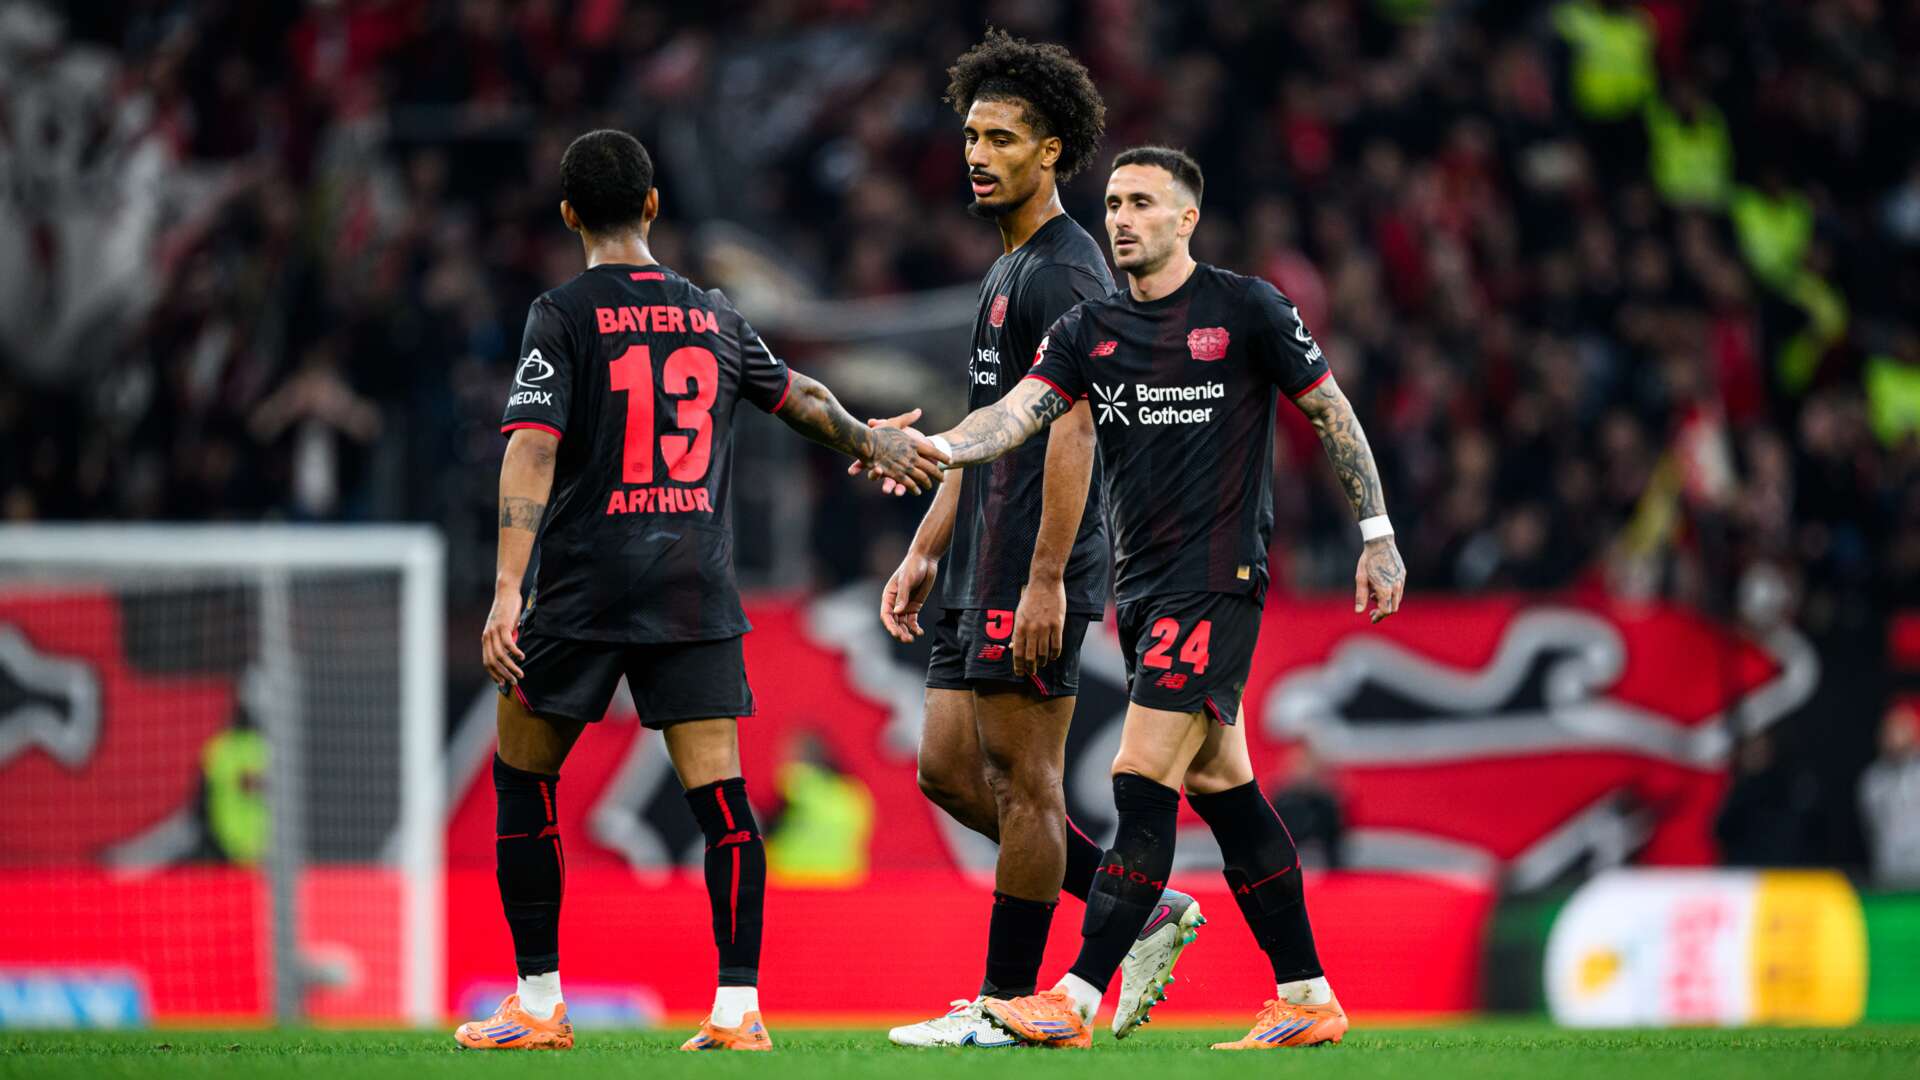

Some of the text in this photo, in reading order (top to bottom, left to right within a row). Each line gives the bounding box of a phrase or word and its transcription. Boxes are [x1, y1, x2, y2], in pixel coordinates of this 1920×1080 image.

[595, 305, 720, 335] BAYER 04
[507, 391, 552, 408] NIEDAX
[1135, 381, 1224, 402] Barmenia
[609, 345, 719, 484] 13
[1138, 406, 1212, 425] Gothaer
[606, 487, 713, 515] ARTHUR
[1143, 617, 1212, 674] 24
